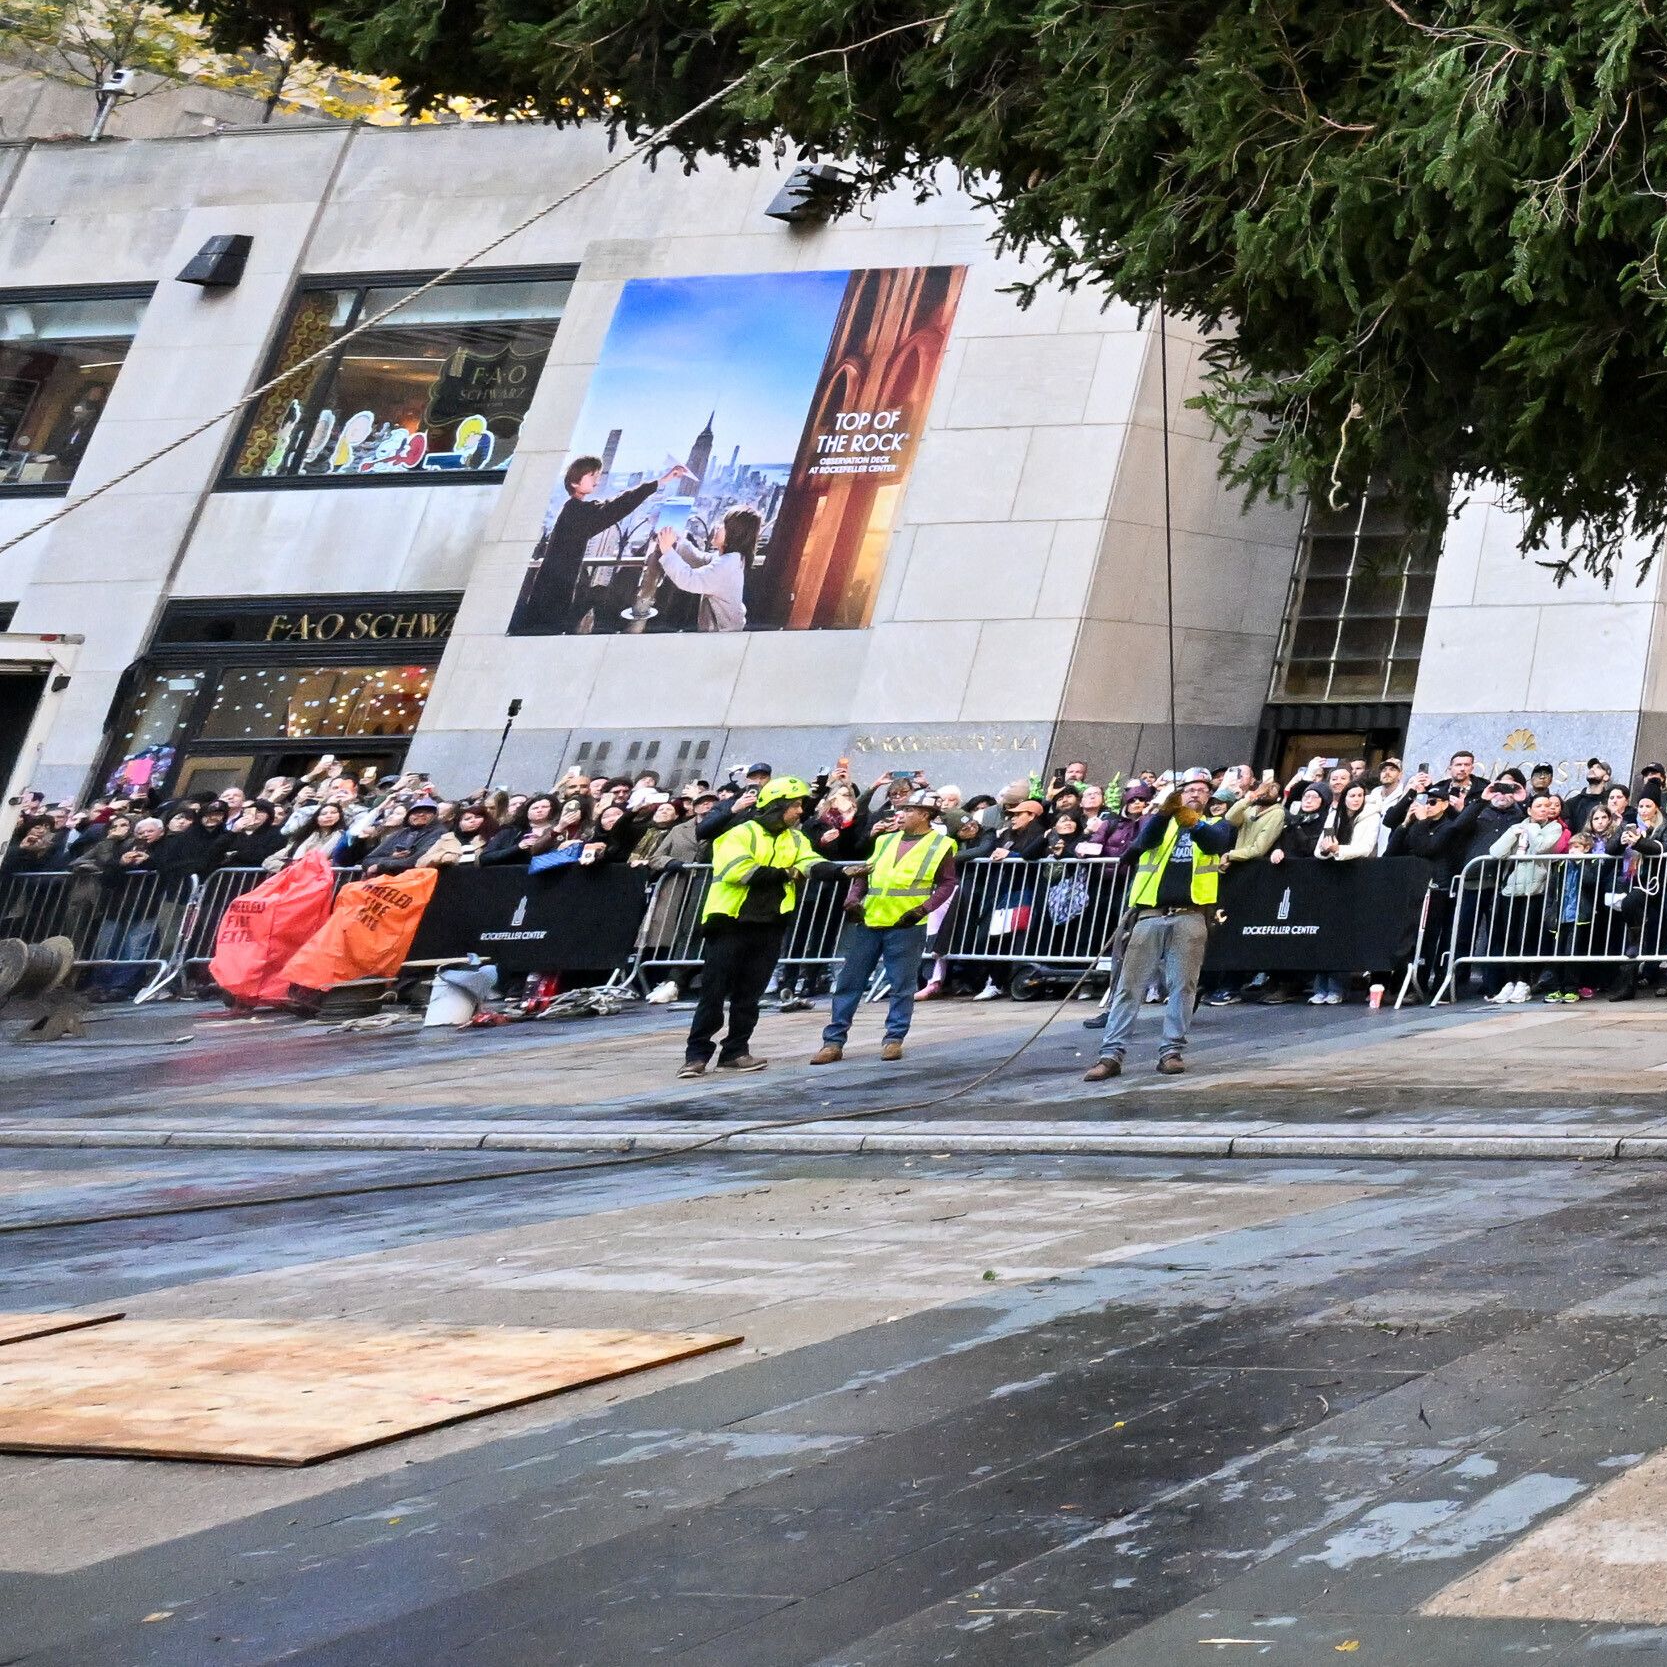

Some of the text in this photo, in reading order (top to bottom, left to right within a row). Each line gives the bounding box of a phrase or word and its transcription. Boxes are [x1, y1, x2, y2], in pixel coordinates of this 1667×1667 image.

[835, 411, 901, 431] TOP OF
[816, 434, 849, 453] THE
[820, 455, 891, 465] OBSERVATION DECK
[808, 464, 897, 474] AT ROCKEFELLER CENTER
[481, 931, 547, 940] ROCKEFELLER CENTER
[1243, 926, 1320, 935] ROCKEFELLER CENTER
